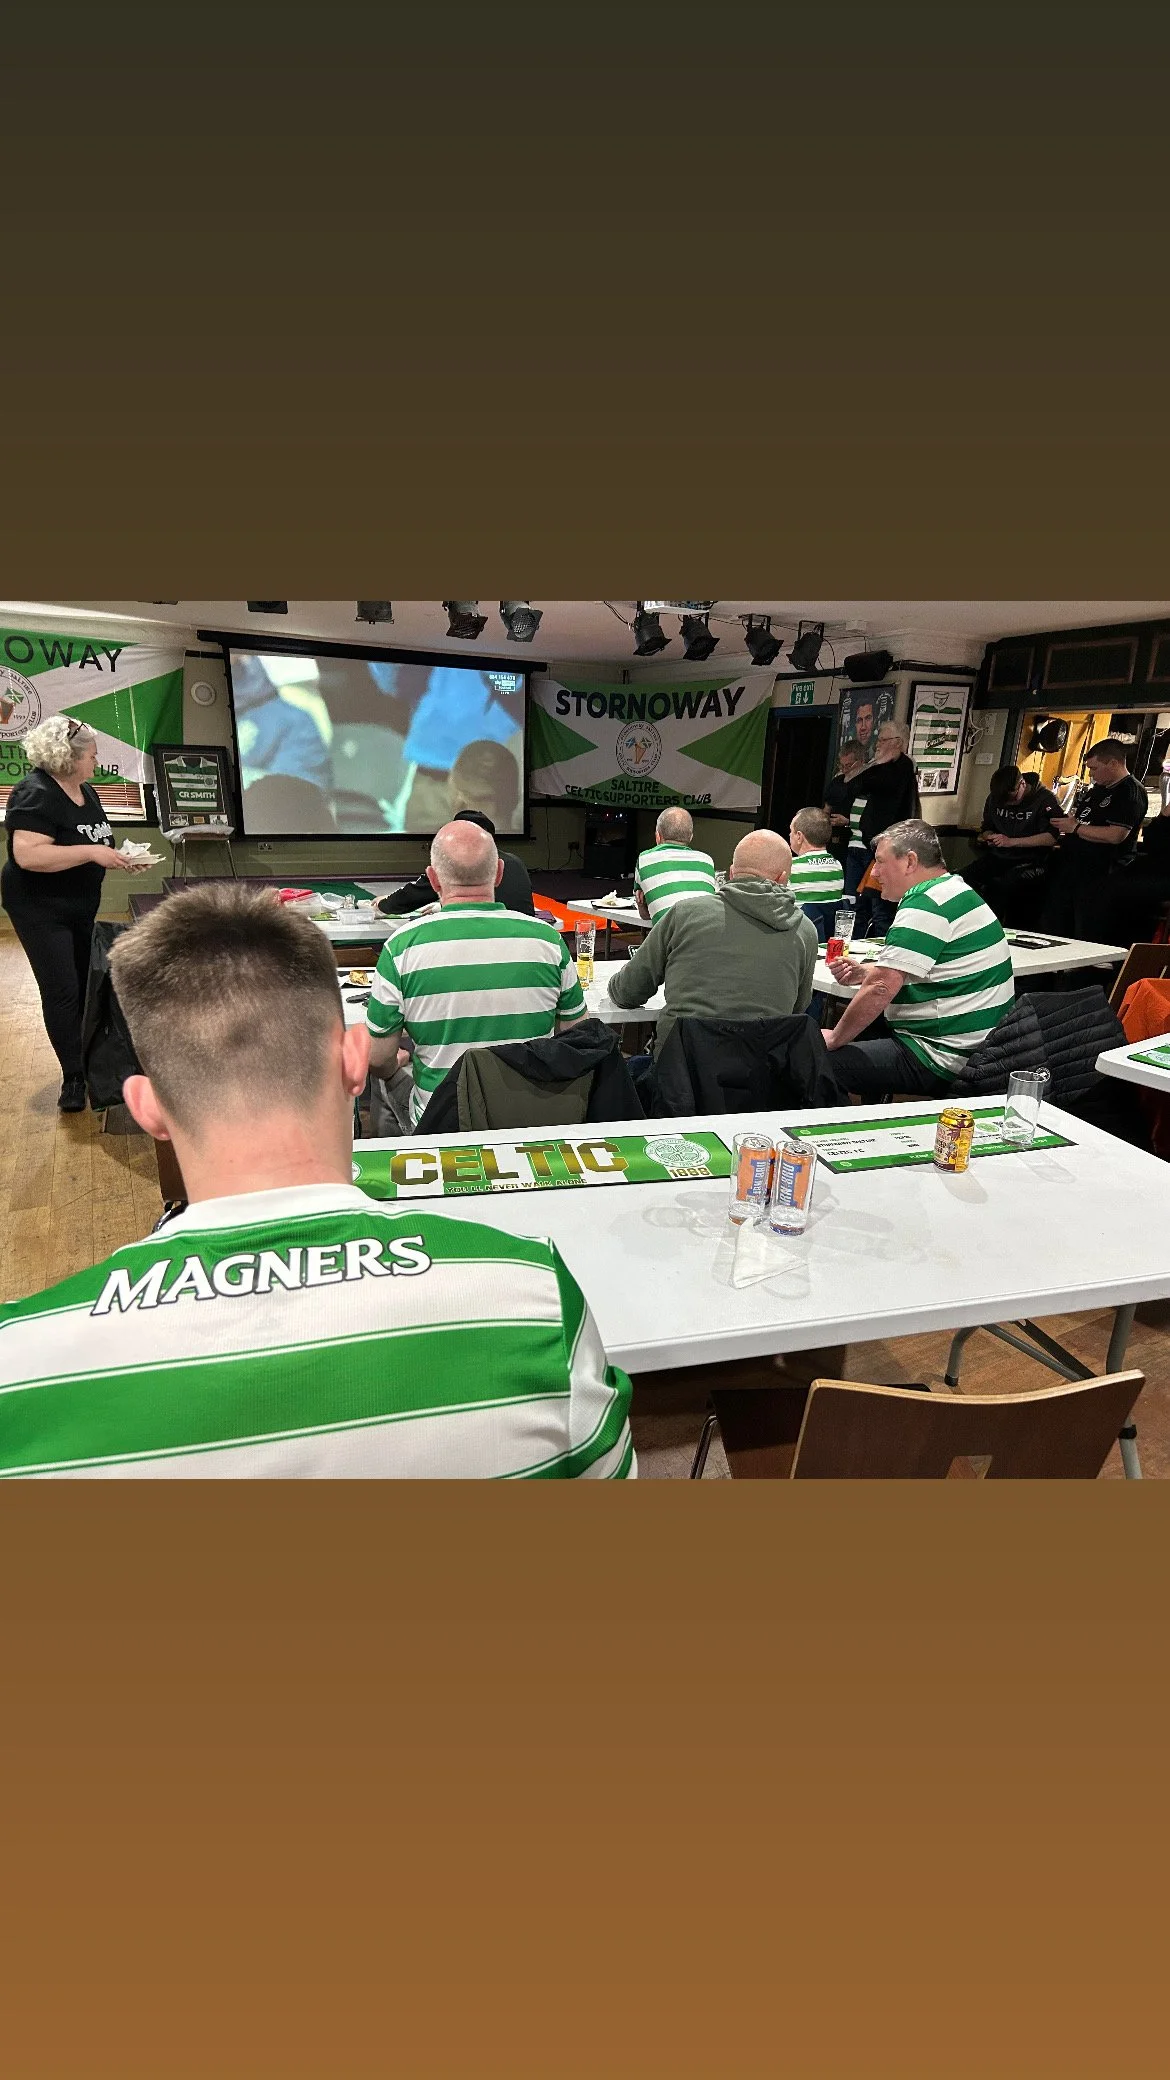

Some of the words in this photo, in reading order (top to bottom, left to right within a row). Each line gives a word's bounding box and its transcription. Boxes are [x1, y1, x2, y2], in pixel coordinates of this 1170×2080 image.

[555, 686, 746, 719] STORNOWAY
[190, 791, 216, 799] SMITH
[565, 784, 602, 800] CELTIC
[603, 792, 680, 806] SUPPORTERS
[683, 793, 711, 805] CLUB
[611, 779, 660, 793] SALTIRE
[390, 1142, 629, 1185] CELTIC
[669, 1167, 710, 1177] 1888
[485, 1183, 519, 1191] NEVER
[521, 1180, 552, 1188] WALK
[90, 1235, 432, 1316] MAGNERS
